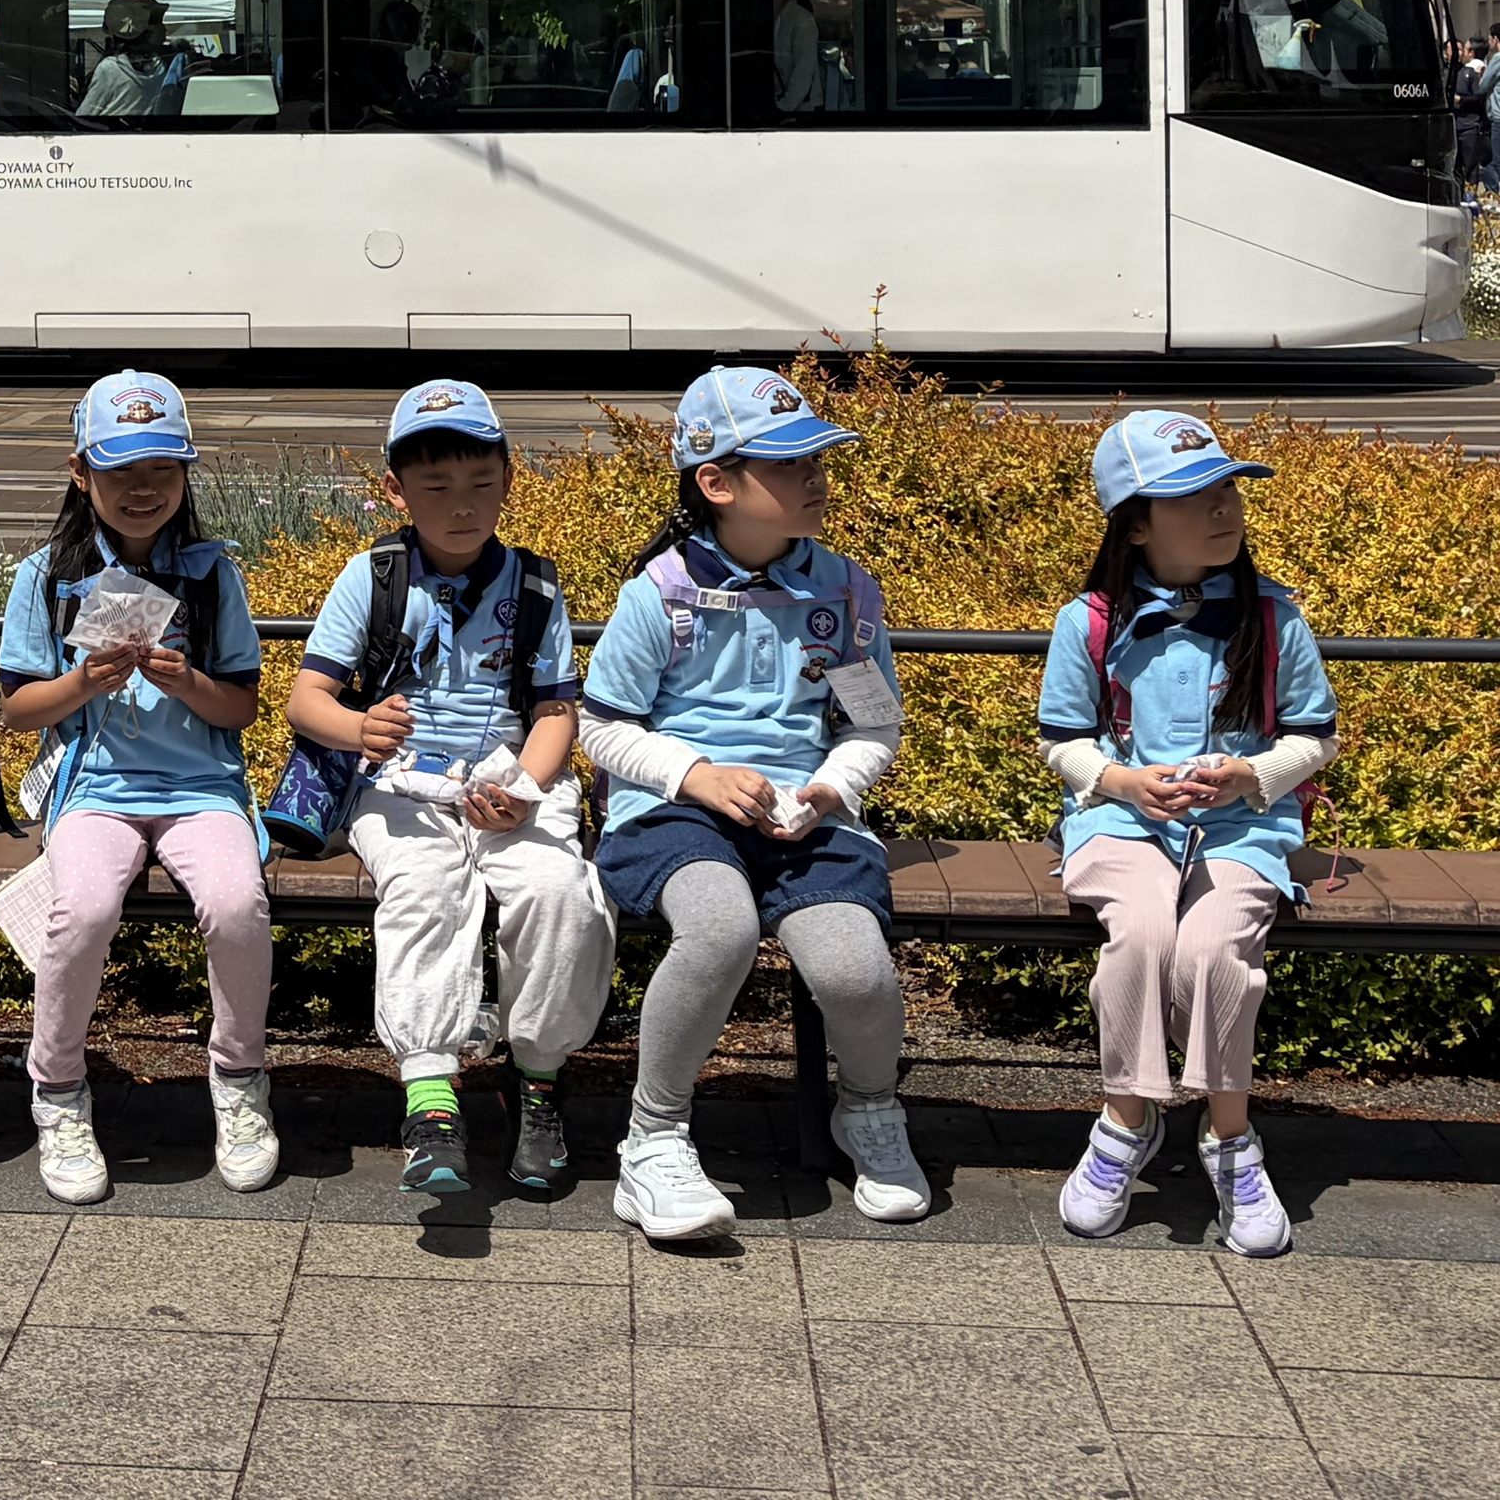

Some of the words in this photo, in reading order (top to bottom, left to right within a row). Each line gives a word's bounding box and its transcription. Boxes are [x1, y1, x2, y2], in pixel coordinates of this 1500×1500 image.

[1393, 84, 1429, 98] 0606A
[46, 162, 74, 173] CITY
[46, 177, 97, 189] CHIHOU
[100, 176, 172, 190] TETSUDOU,
[174, 176, 192, 189] Inc
